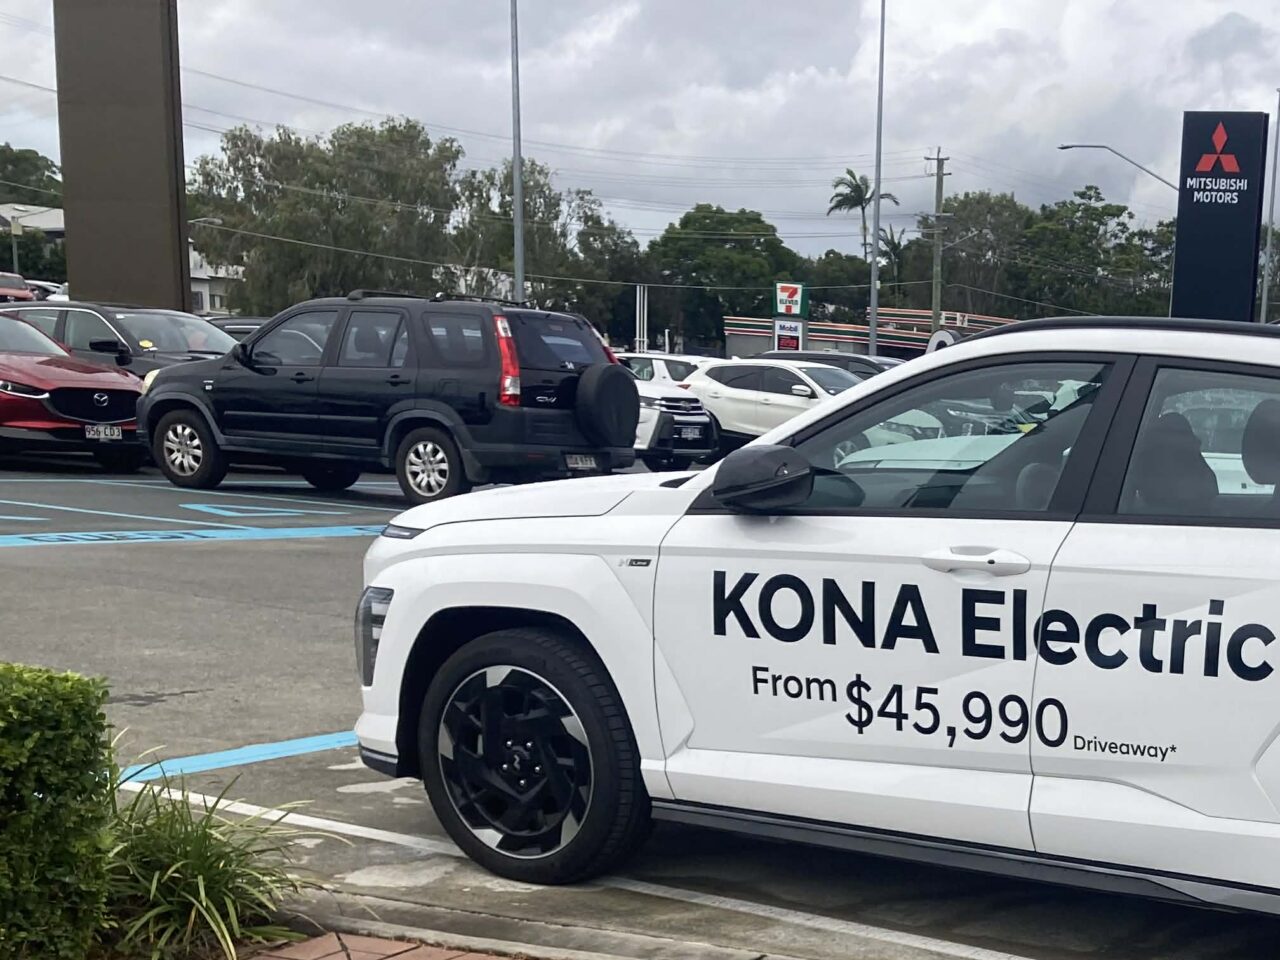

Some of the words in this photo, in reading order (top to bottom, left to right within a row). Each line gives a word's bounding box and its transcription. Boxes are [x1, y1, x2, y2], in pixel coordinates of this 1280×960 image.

[1186, 177, 1248, 190] MITSUBISHI
[1193, 191, 1239, 203] MOTORS
[779, 323, 799, 332] Mobil
[713, 570, 940, 654] KONA
[962, 588, 1276, 682] Electric
[752, 666, 837, 702] From
[845, 673, 1068, 748] $45,990
